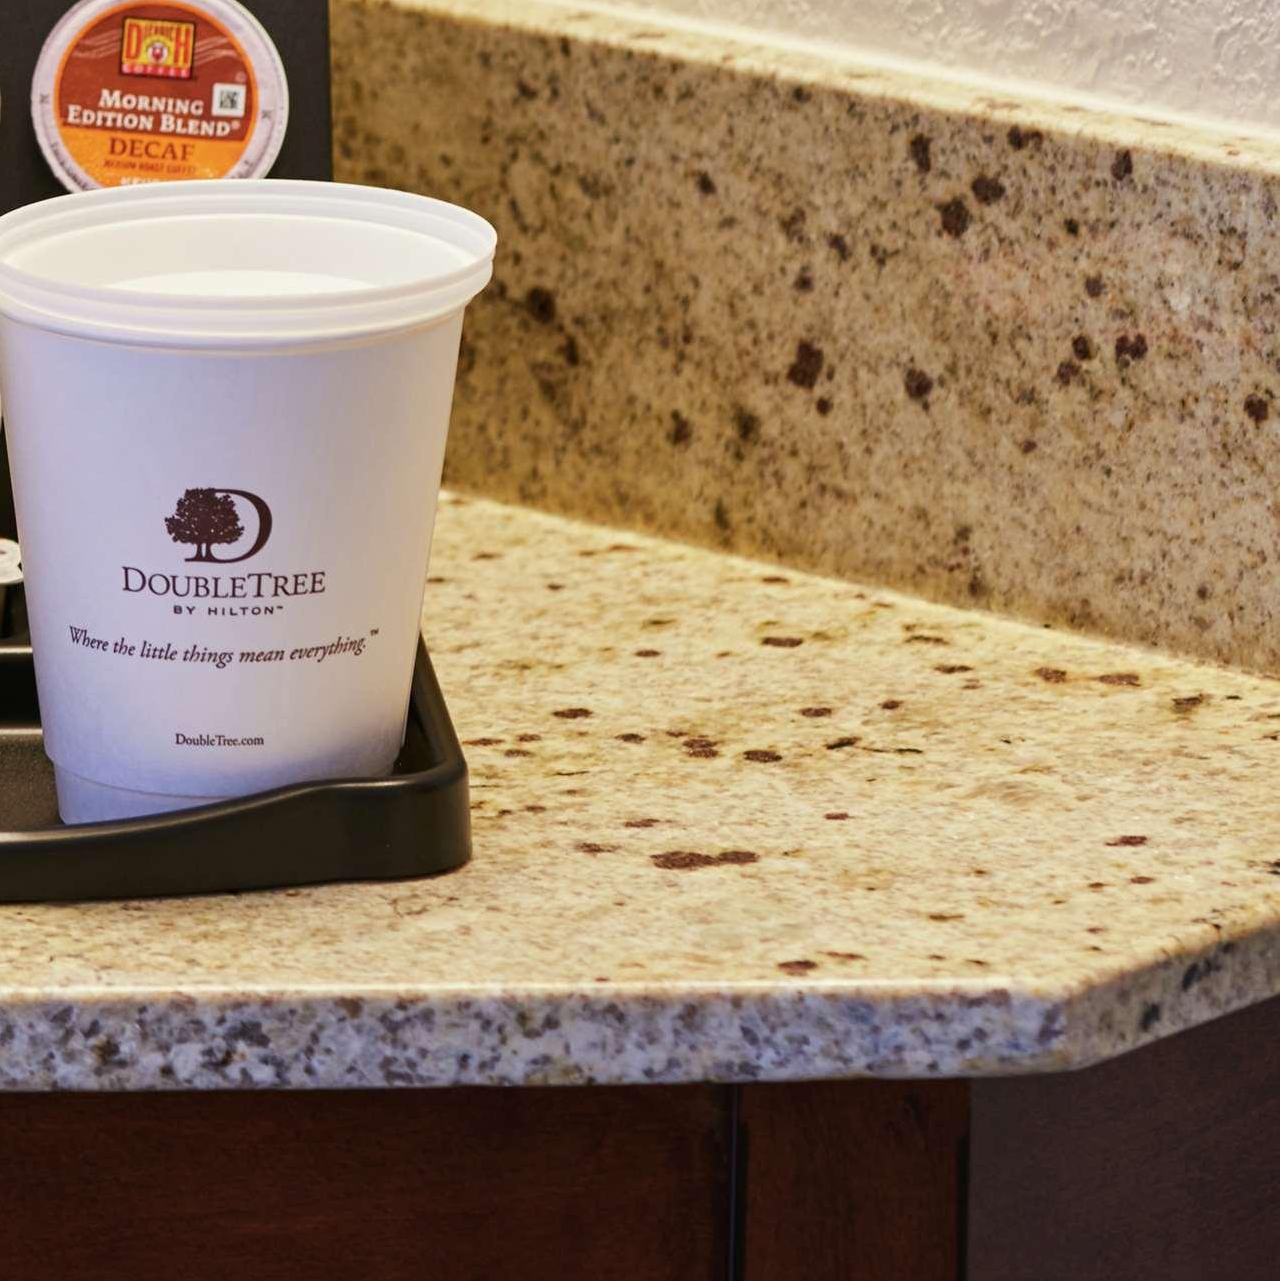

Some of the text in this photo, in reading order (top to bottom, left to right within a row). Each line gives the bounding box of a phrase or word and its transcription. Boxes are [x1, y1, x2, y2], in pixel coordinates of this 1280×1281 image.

[99, 88, 205, 116] MORNING
[67, 105, 154, 131] EDITION
[108, 137, 196, 162] DECAF
[120, 566, 326, 599] DOUBLETREE
[173, 605, 196, 615] BY
[69, 626, 110, 653] Where
[113, 637, 136, 657] the
[140, 640, 178, 662] little
[183, 645, 234, 669] things
[239, 648, 285, 663] mean
[174, 733, 265, 747] DoubleTree.com
